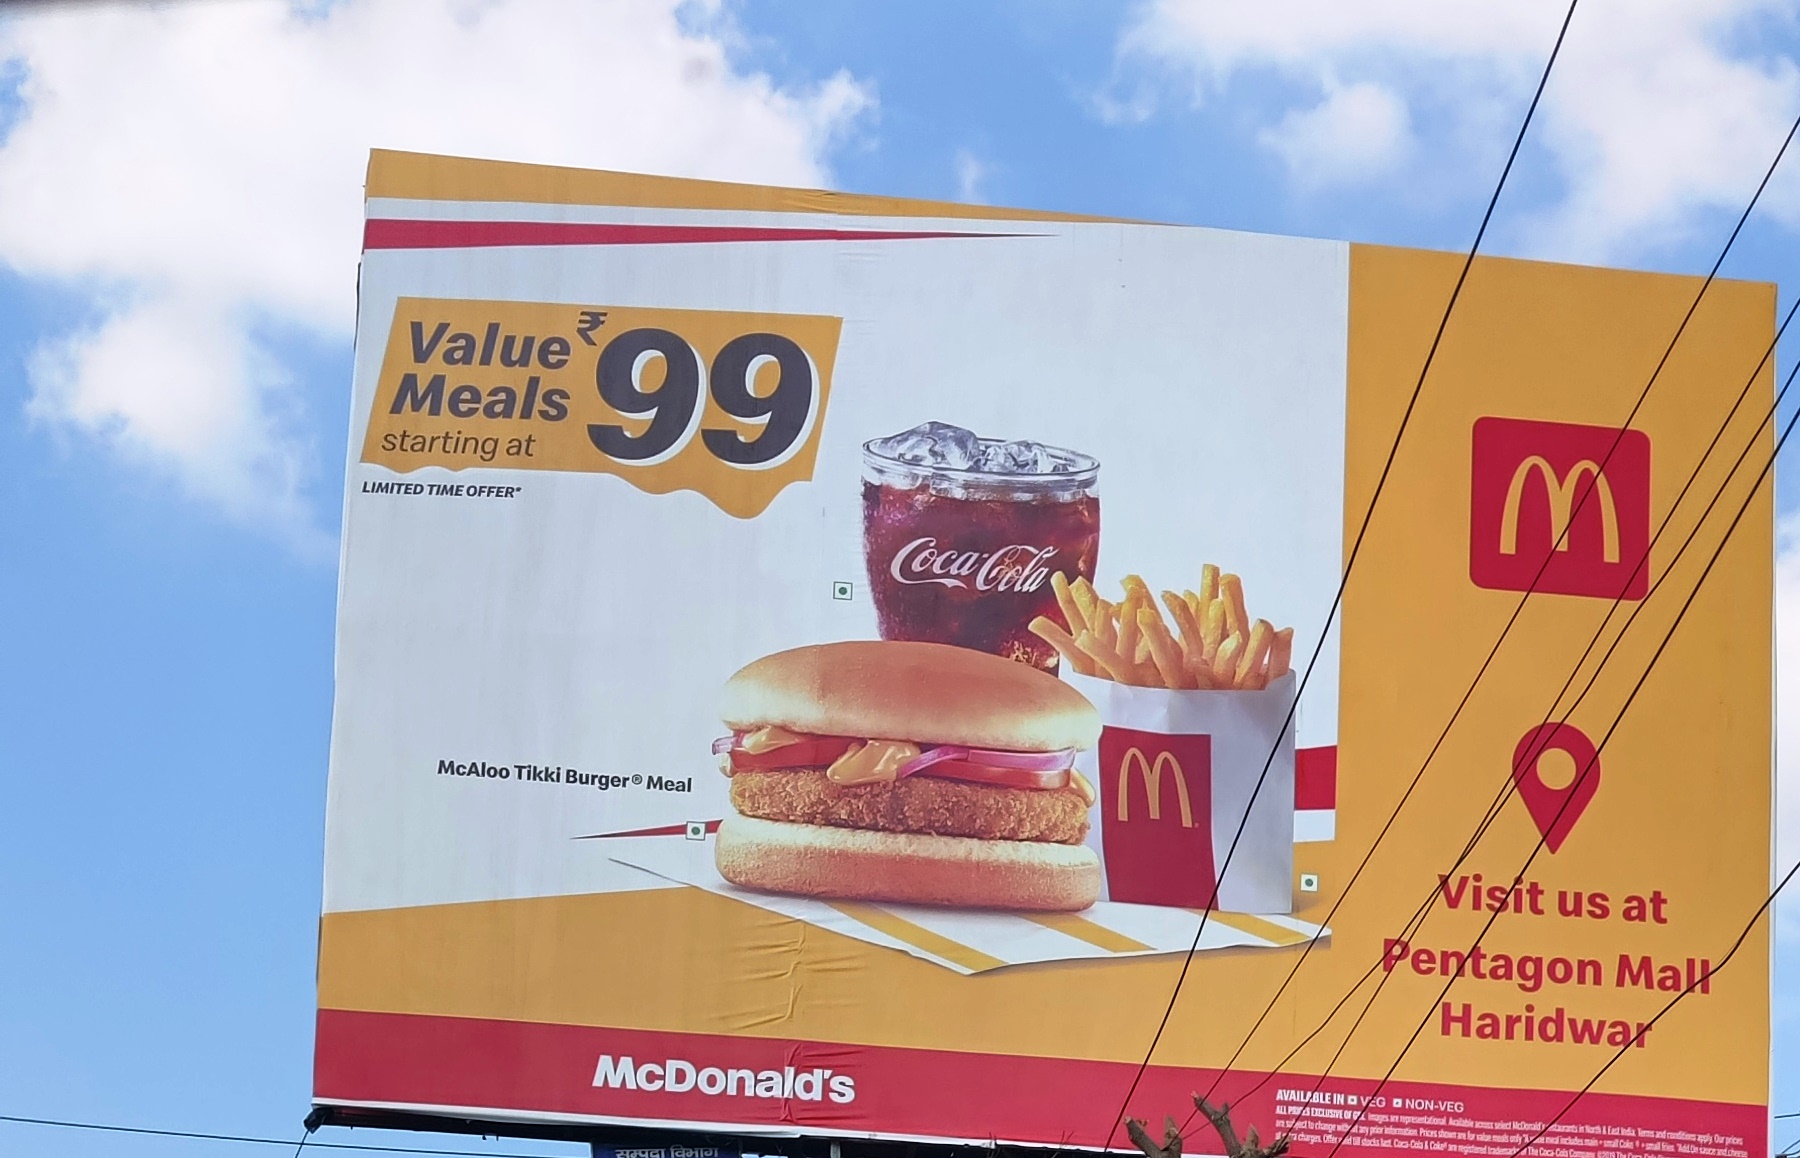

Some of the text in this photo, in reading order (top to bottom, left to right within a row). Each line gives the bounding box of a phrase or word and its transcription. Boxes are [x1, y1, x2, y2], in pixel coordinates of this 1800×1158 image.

[409, 320, 571, 369] Value
[389, 373, 571, 422] Meals
[380, 428, 536, 462] starting at
[362, 480, 423, 496] LIMITED
[426, 482, 464, 498] TIME
[437, 760, 510, 780] McAloo
[514, 764, 561, 784] Tikki
[646, 775, 692, 792] Meal
[1437, 873, 1668, 924] Visit us at
[1382, 938, 1711, 995] Pentagon Mall
[1440, 1002, 1652, 1048] Haridwar
[592, 1054, 856, 1104] McDonald's
[1275, 1089, 1464, 1113] AVAILABLE IN VEG NON-VEG
[669, 1145, 719, 1158] विभाग
